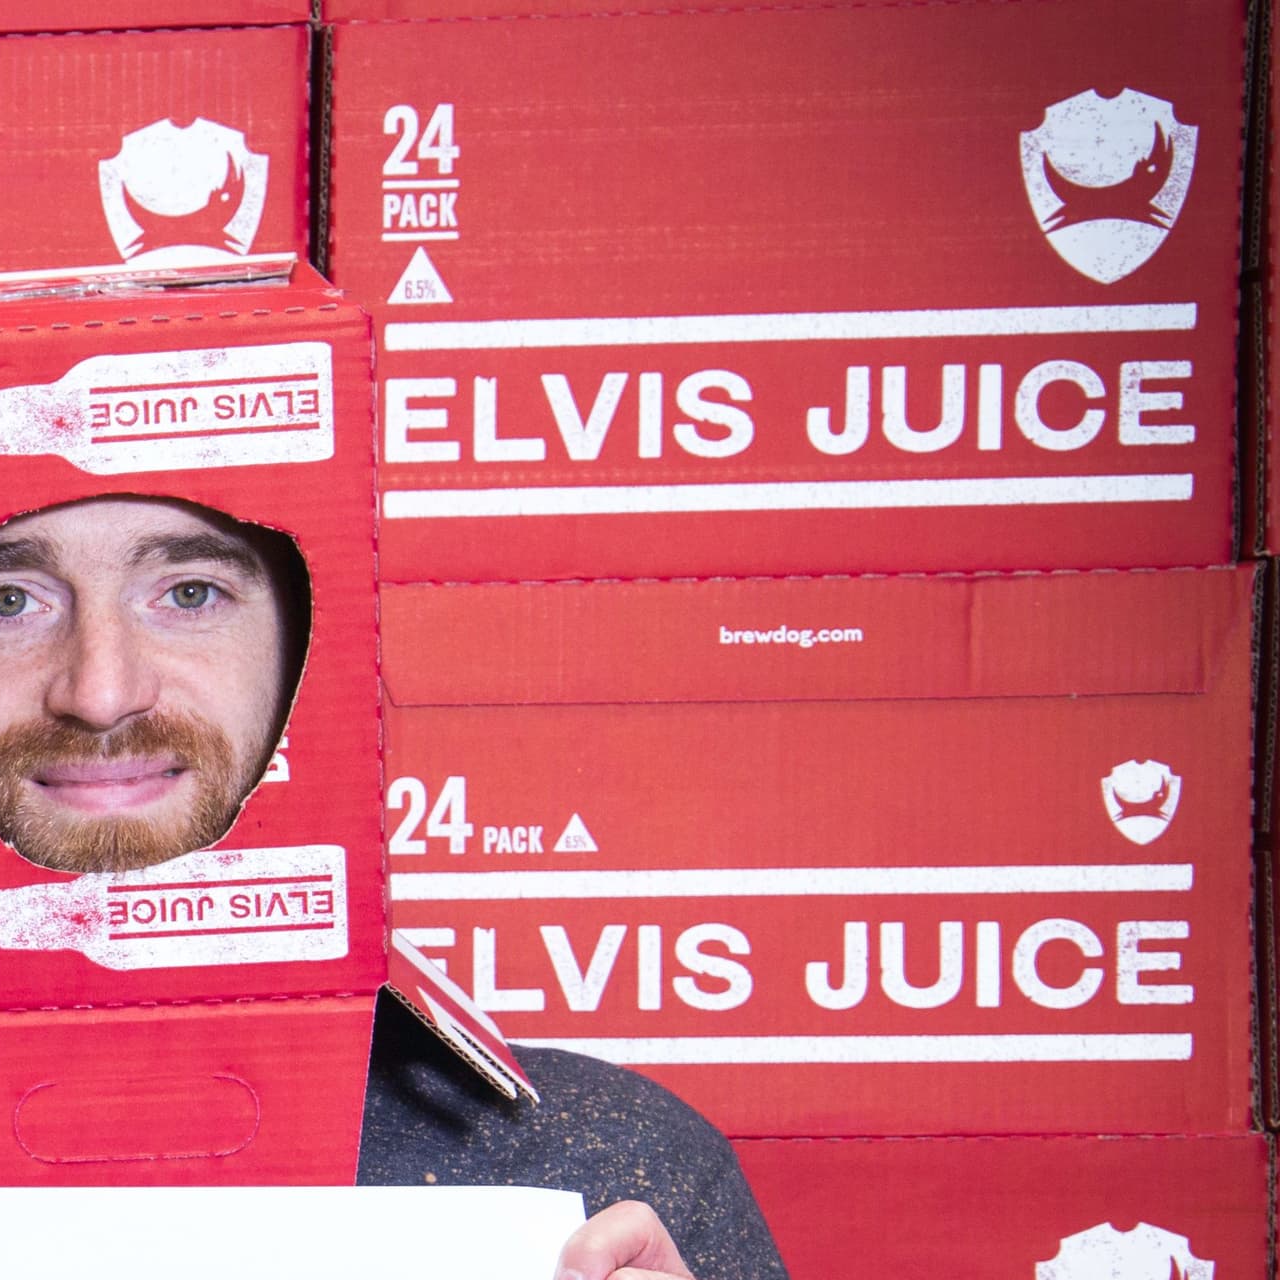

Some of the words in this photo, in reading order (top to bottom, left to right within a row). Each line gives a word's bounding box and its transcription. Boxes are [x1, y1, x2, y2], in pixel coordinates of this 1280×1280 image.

[383, 104, 459, 175] 24
[383, 193, 458, 228] PACK
[403, 279, 436, 300] 6.5%
[89, 396, 199, 428] JUICE
[213, 388, 320, 421] ELVIS
[385, 370, 753, 463] ELVIS
[807, 360, 1194, 455] JUICE
[720, 625, 862, 648] brewdog.com
[388, 777, 473, 854] 24
[484, 826, 543, 853] PACK
[107, 895, 215, 925] JUICE
[229, 889, 334, 919] ELVIS
[806, 919, 1193, 1009] JUICE
